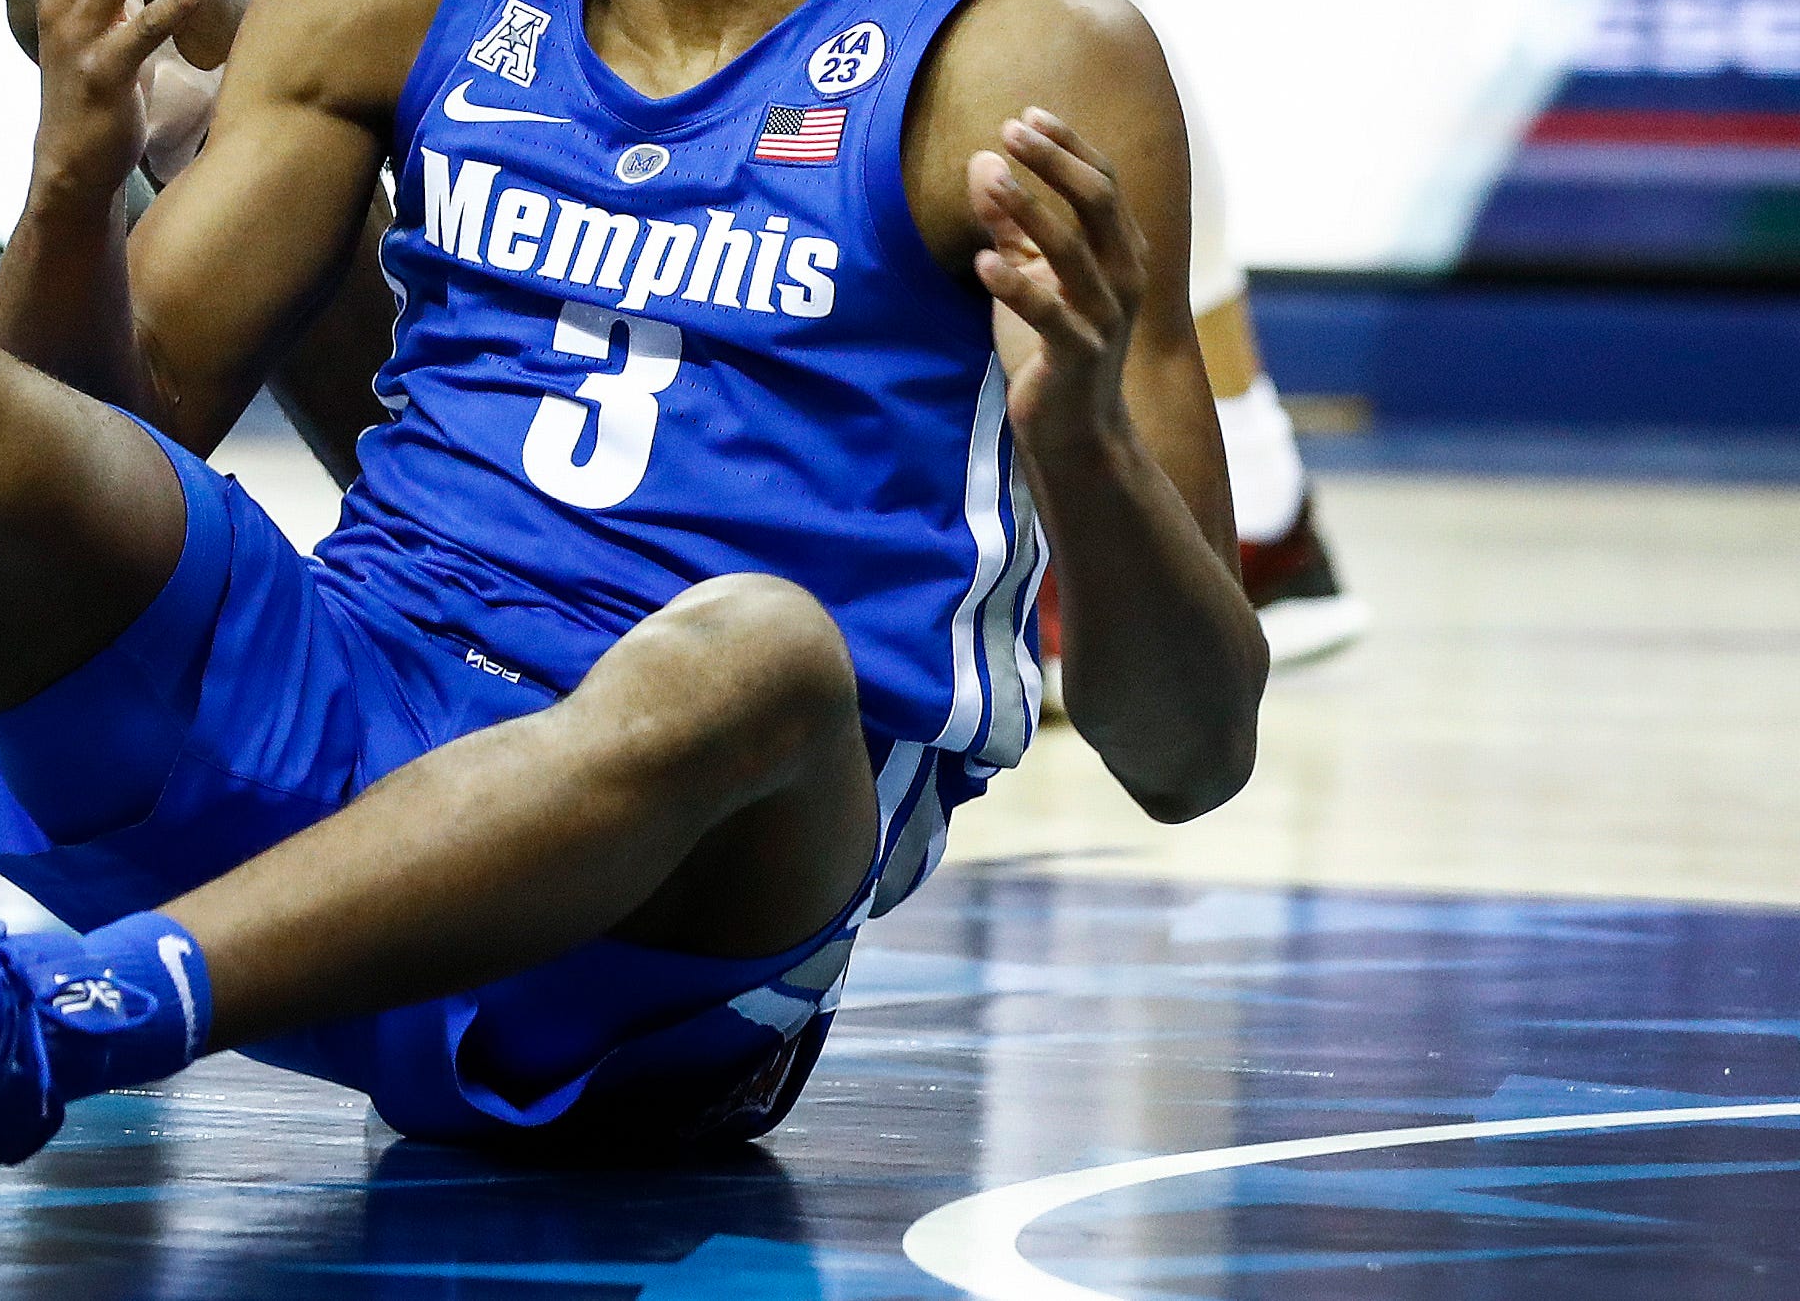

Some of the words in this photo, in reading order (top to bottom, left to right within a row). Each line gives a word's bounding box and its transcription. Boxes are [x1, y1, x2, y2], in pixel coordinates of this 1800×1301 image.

[818, 57, 861, 84] 23
[828, 31, 871, 55] KA
[420, 147, 840, 319] Memphis
[522, 300, 682, 511] 3
